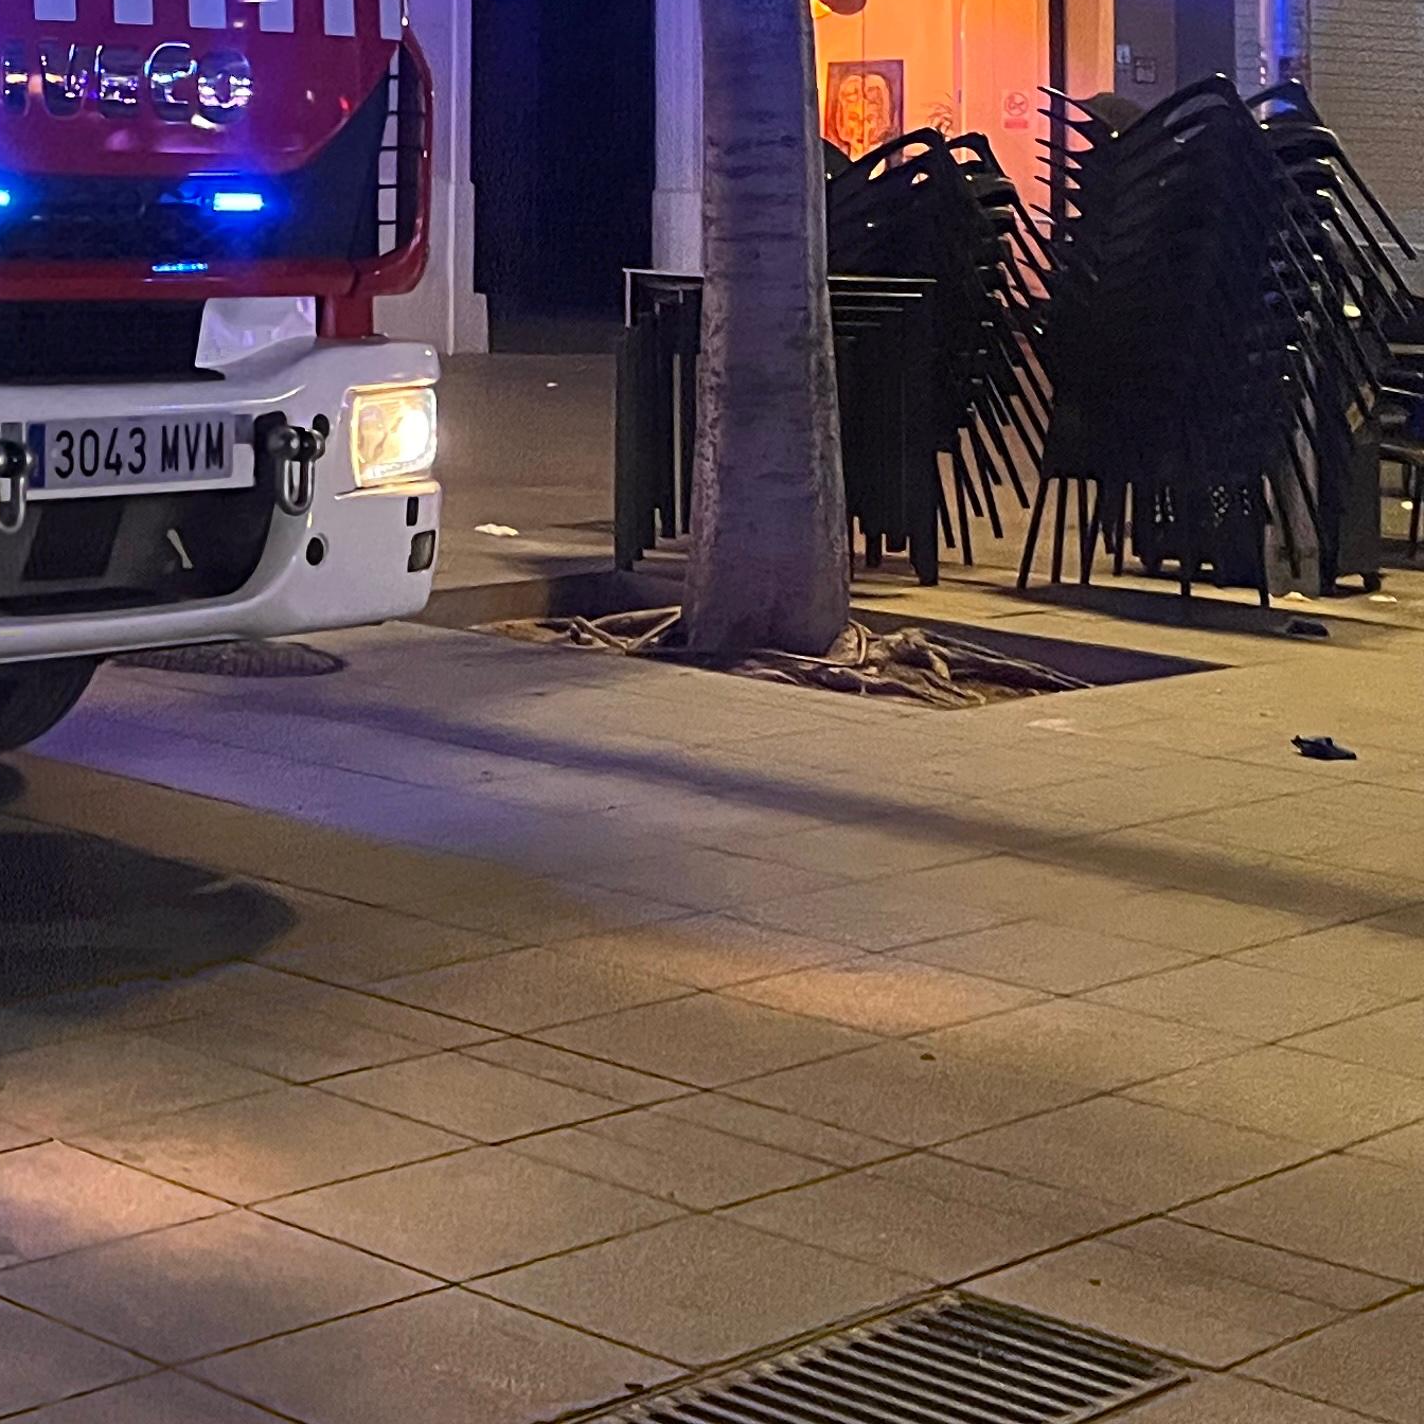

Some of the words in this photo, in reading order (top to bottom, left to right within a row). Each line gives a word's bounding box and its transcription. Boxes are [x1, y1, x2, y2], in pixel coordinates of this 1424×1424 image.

[2, 38, 251, 124] IVECO
[55, 427, 146, 479] 3043
[161, 422, 224, 473] MVM
